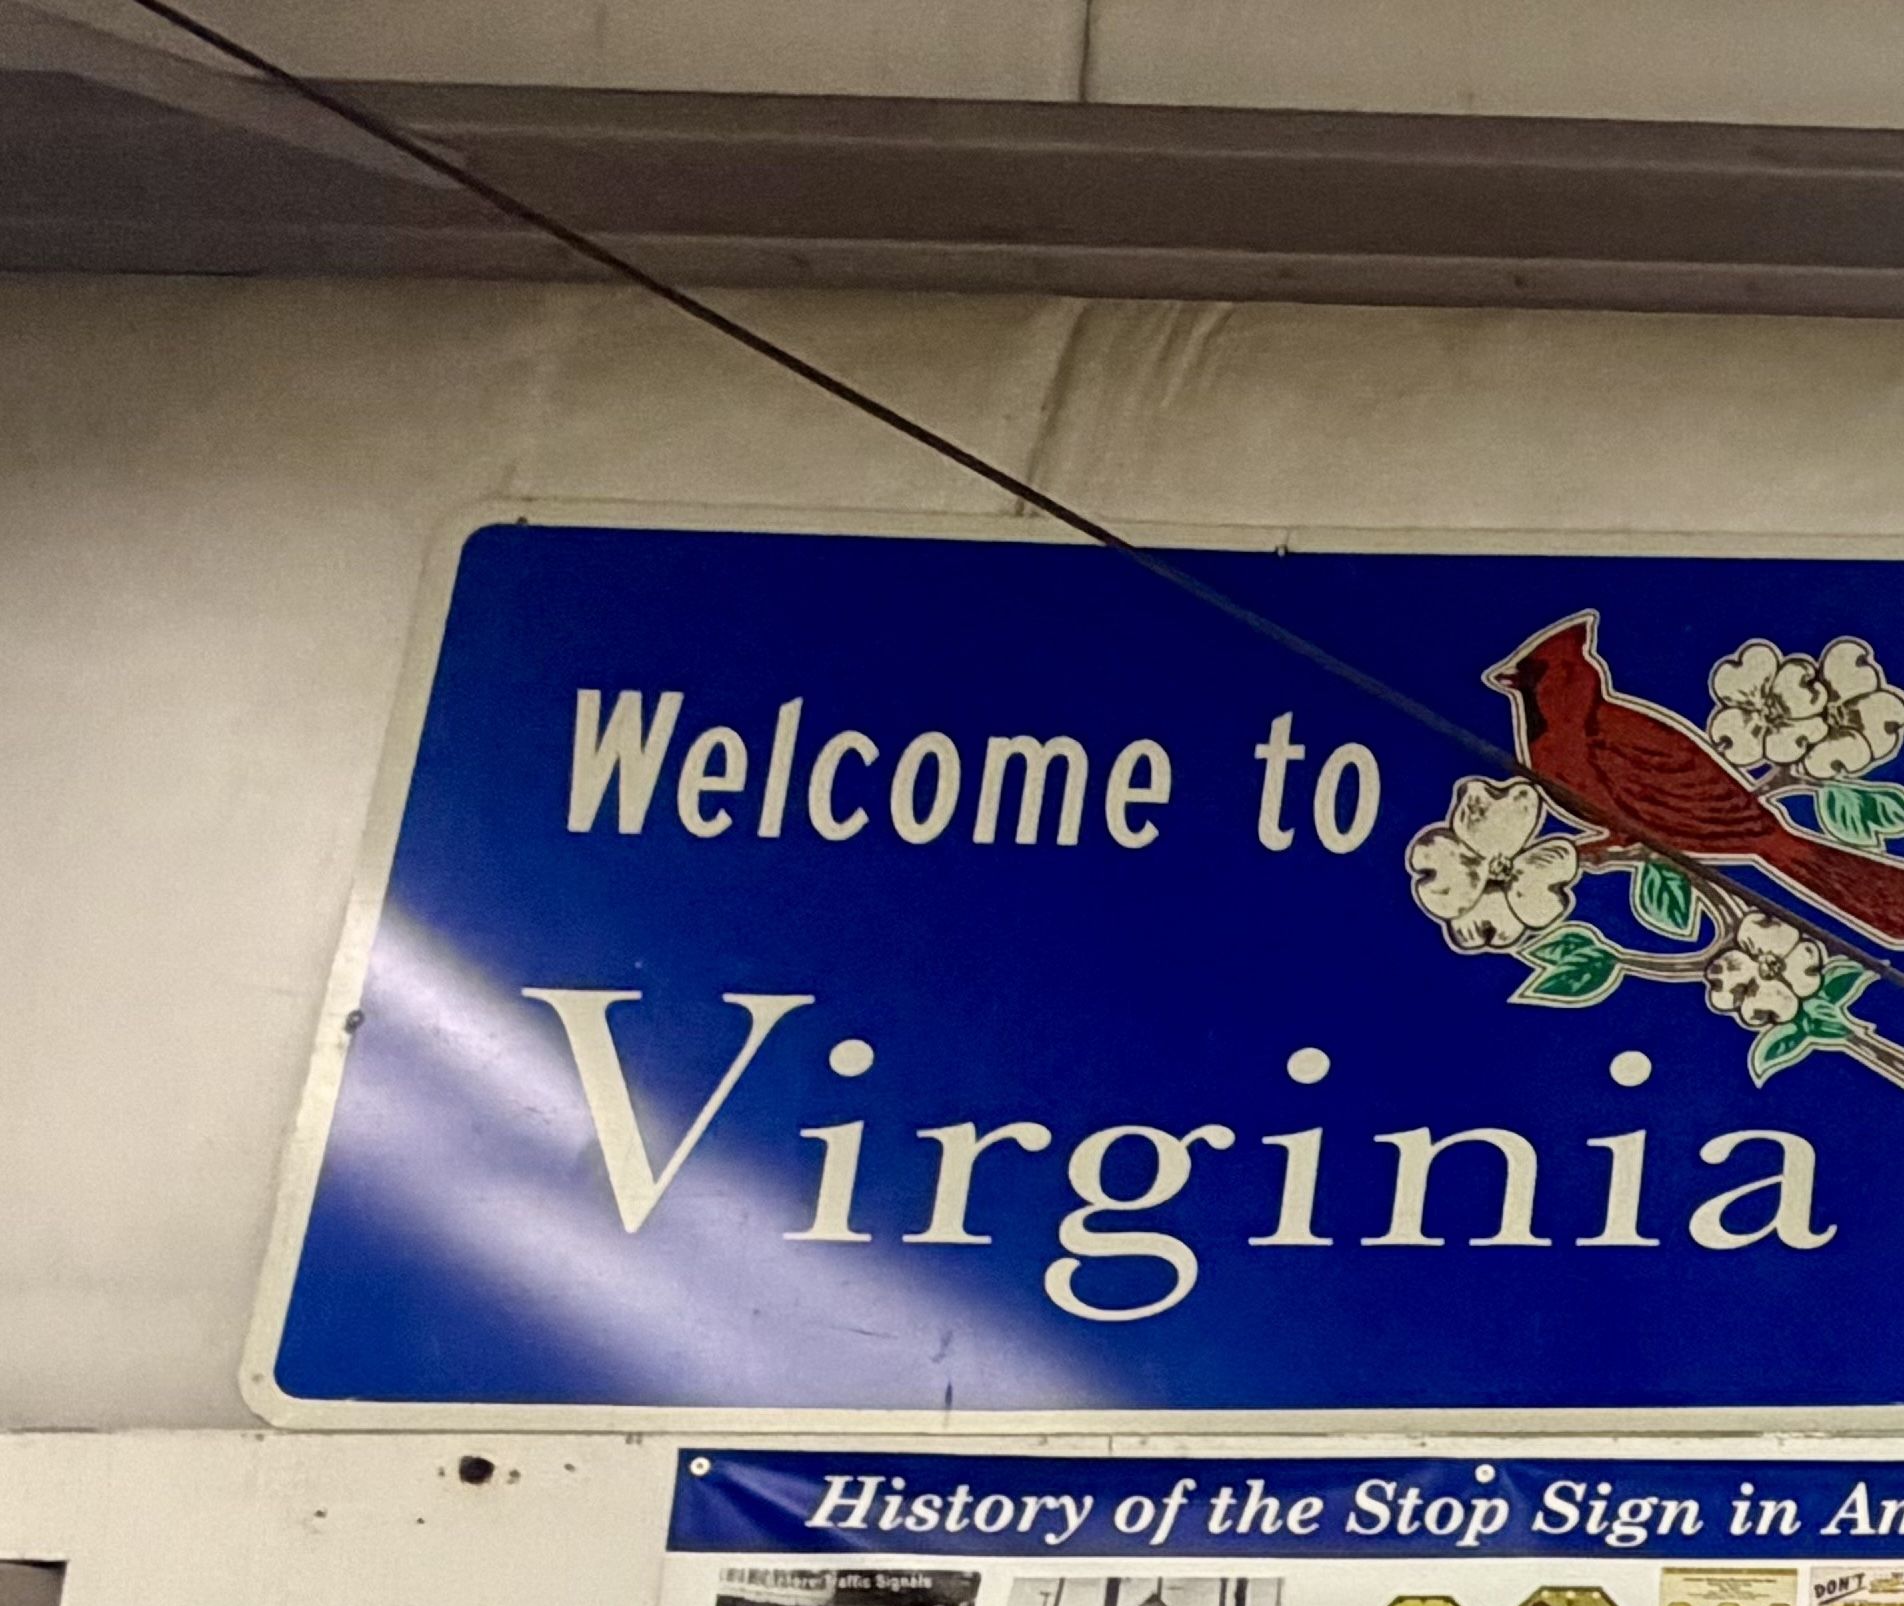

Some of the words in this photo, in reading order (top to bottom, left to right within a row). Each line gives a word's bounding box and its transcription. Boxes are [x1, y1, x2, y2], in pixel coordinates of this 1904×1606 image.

[566, 687, 1173, 851] Welcome
[1255, 713, 1381, 854] to
[521, 987, 1838, 1321] Virginia
[805, 1476, 1093, 1545] History
[1115, 1477, 1197, 1546] of
[1213, 1476, 1328, 1535] the
[1342, 1476, 1511, 1545] Stop
[1533, 1476, 1706, 1545] Sign
[1730, 1476, 1801, 1535] in
